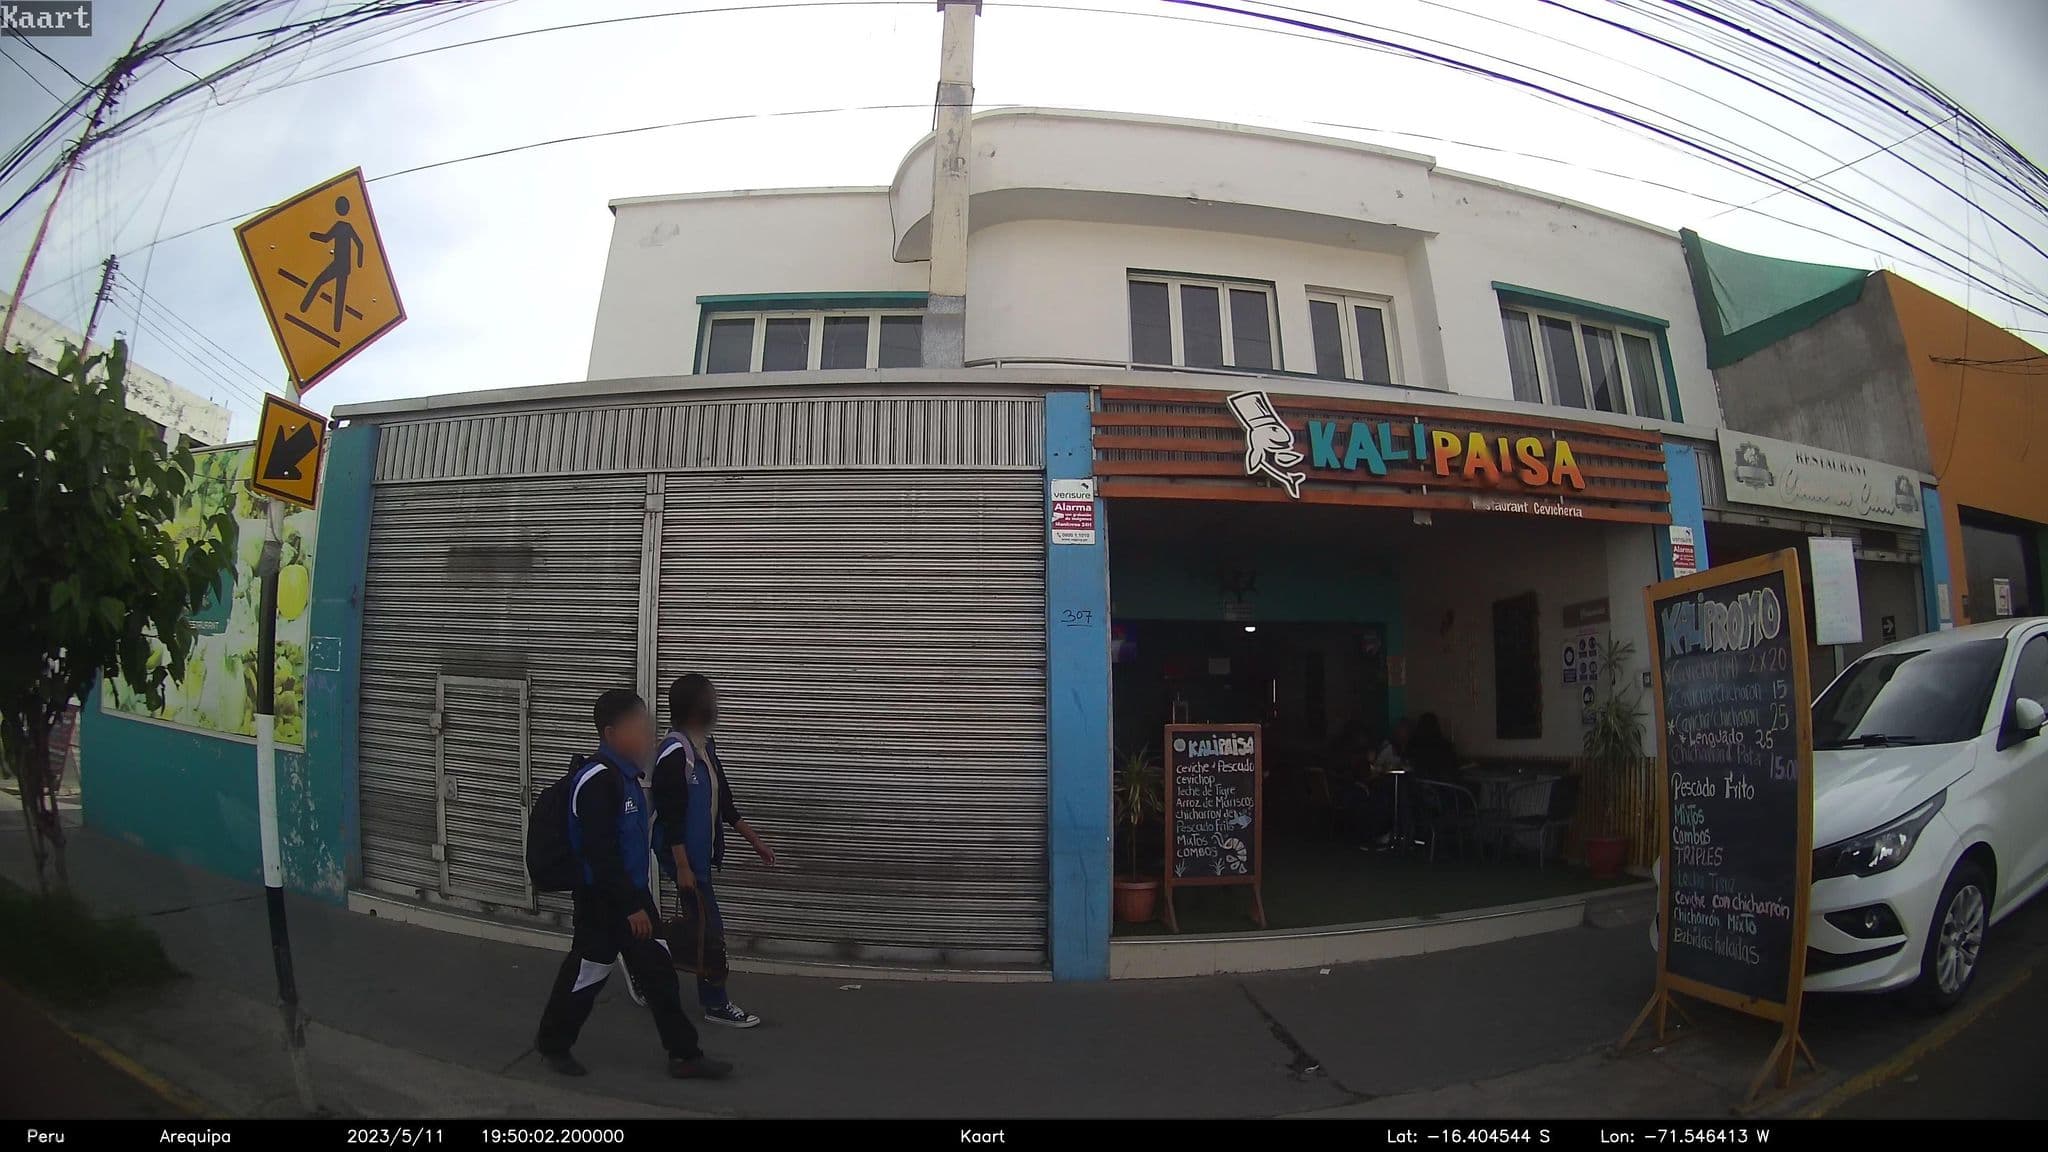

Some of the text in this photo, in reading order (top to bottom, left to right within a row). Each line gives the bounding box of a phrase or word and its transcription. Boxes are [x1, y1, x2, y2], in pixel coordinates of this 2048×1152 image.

[1054, 491, 1091, 499] verisure
[1055, 502, 1092, 511] Alarma
[1061, 609, 1093, 625] 307
[1202, 785, 1213, 797] de
[1671, 770, 1755, 801] Pescado Frito
[1674, 846, 1724, 867] TRIPLES
